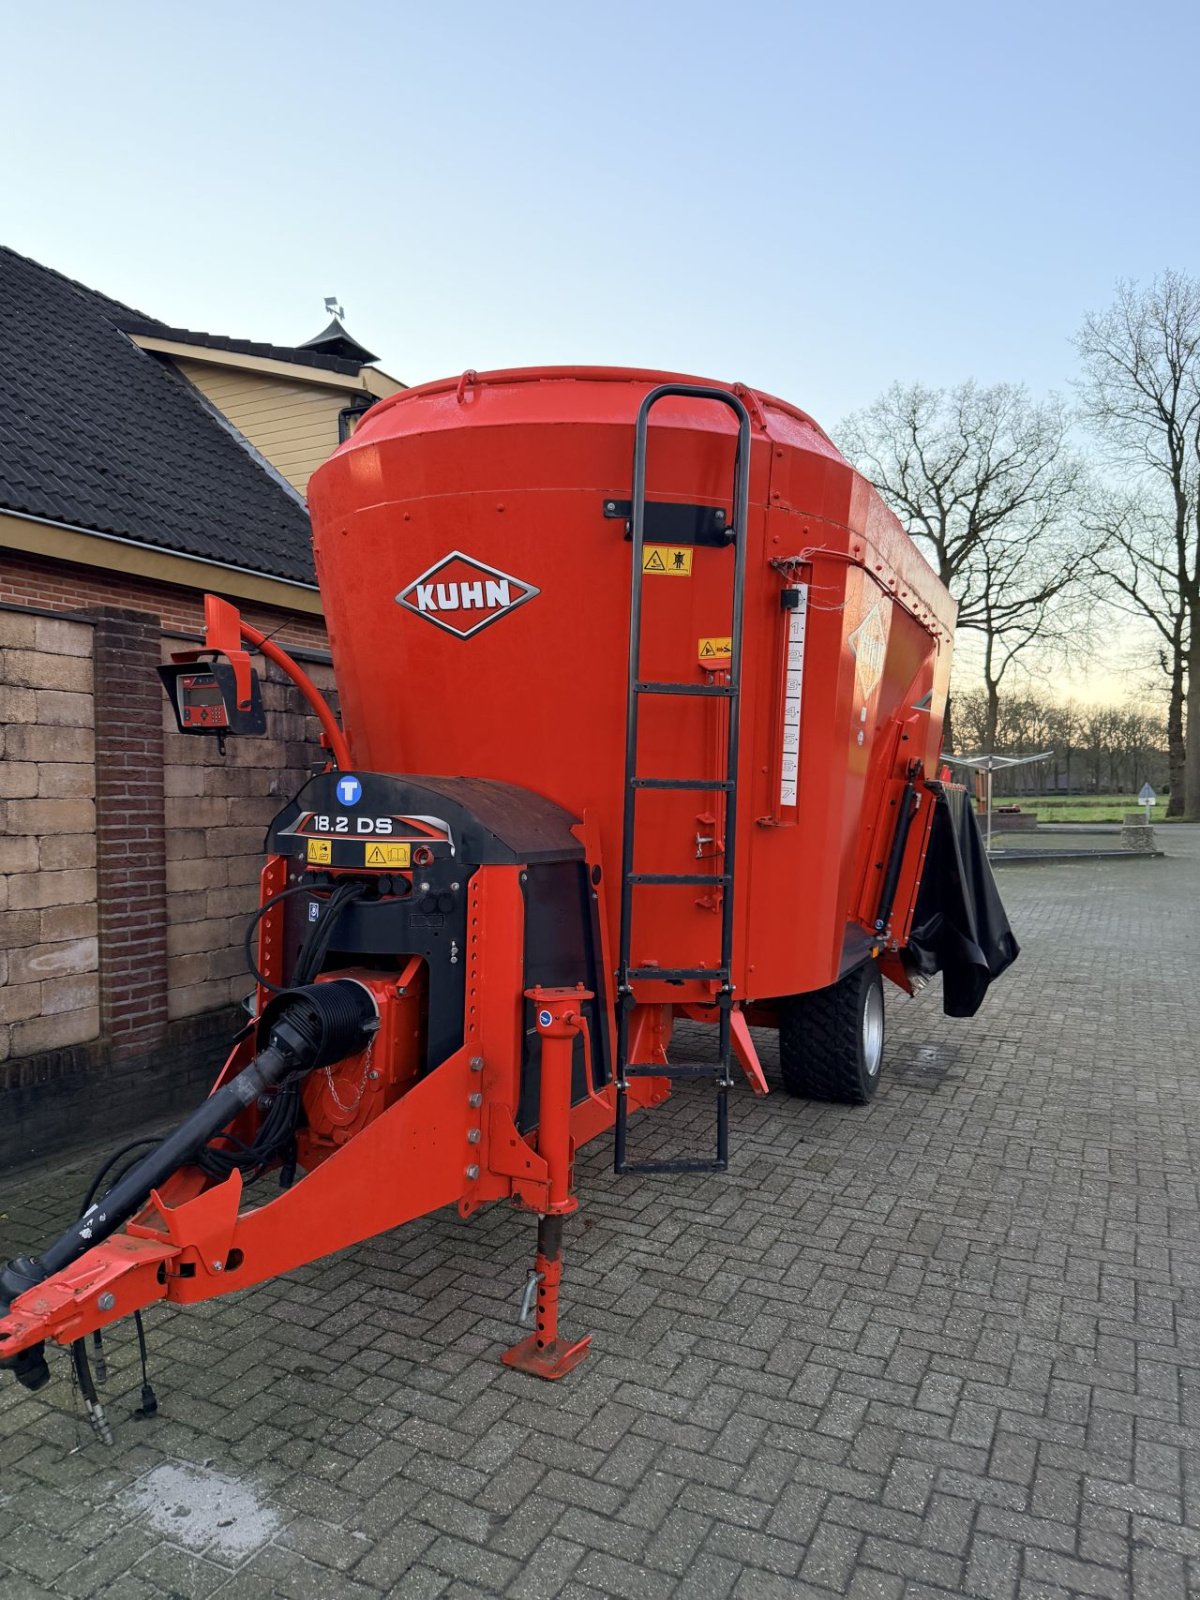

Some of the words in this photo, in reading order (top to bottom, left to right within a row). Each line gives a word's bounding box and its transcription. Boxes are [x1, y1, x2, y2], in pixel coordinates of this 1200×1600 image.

[416, 579, 511, 611] KUHN
[791, 621, 800, 635] 1
[789, 649, 801, 662] 2
[787, 678, 799, 691] 3
[785, 706, 796, 719] 4
[784, 732, 796, 745] 5
[340, 781, 358, 801] T
[781, 786, 793, 799] 7
[313, 815, 349, 833] 18.2
[356, 817, 393, 834] DS
